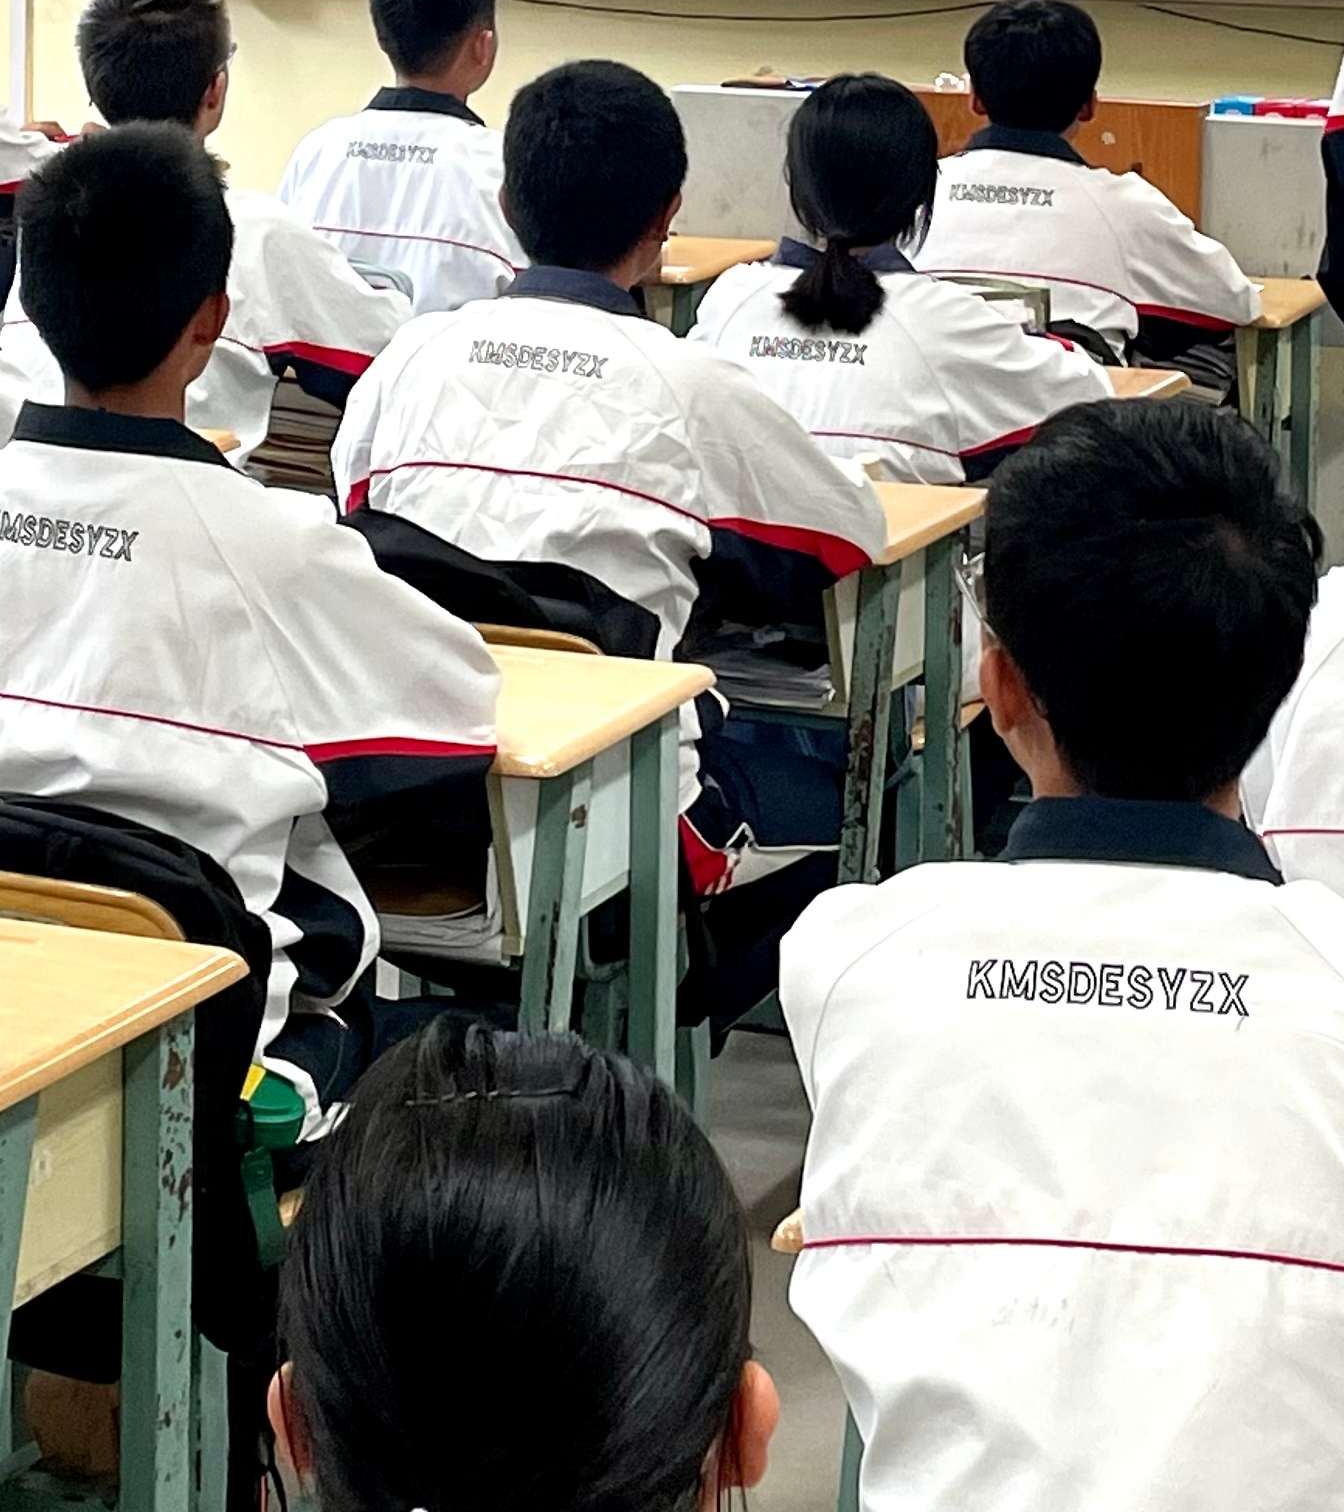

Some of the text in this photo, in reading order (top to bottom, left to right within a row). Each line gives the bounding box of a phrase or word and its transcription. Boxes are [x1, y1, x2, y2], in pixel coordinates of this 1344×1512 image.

[948, 183, 1055, 207] KMSDESYZX
[468, 339, 608, 379] KMSDESYZX
[748, 336, 868, 365] KMSDESYZX
[966, 959, 1249, 1017] KMSDESYZX
